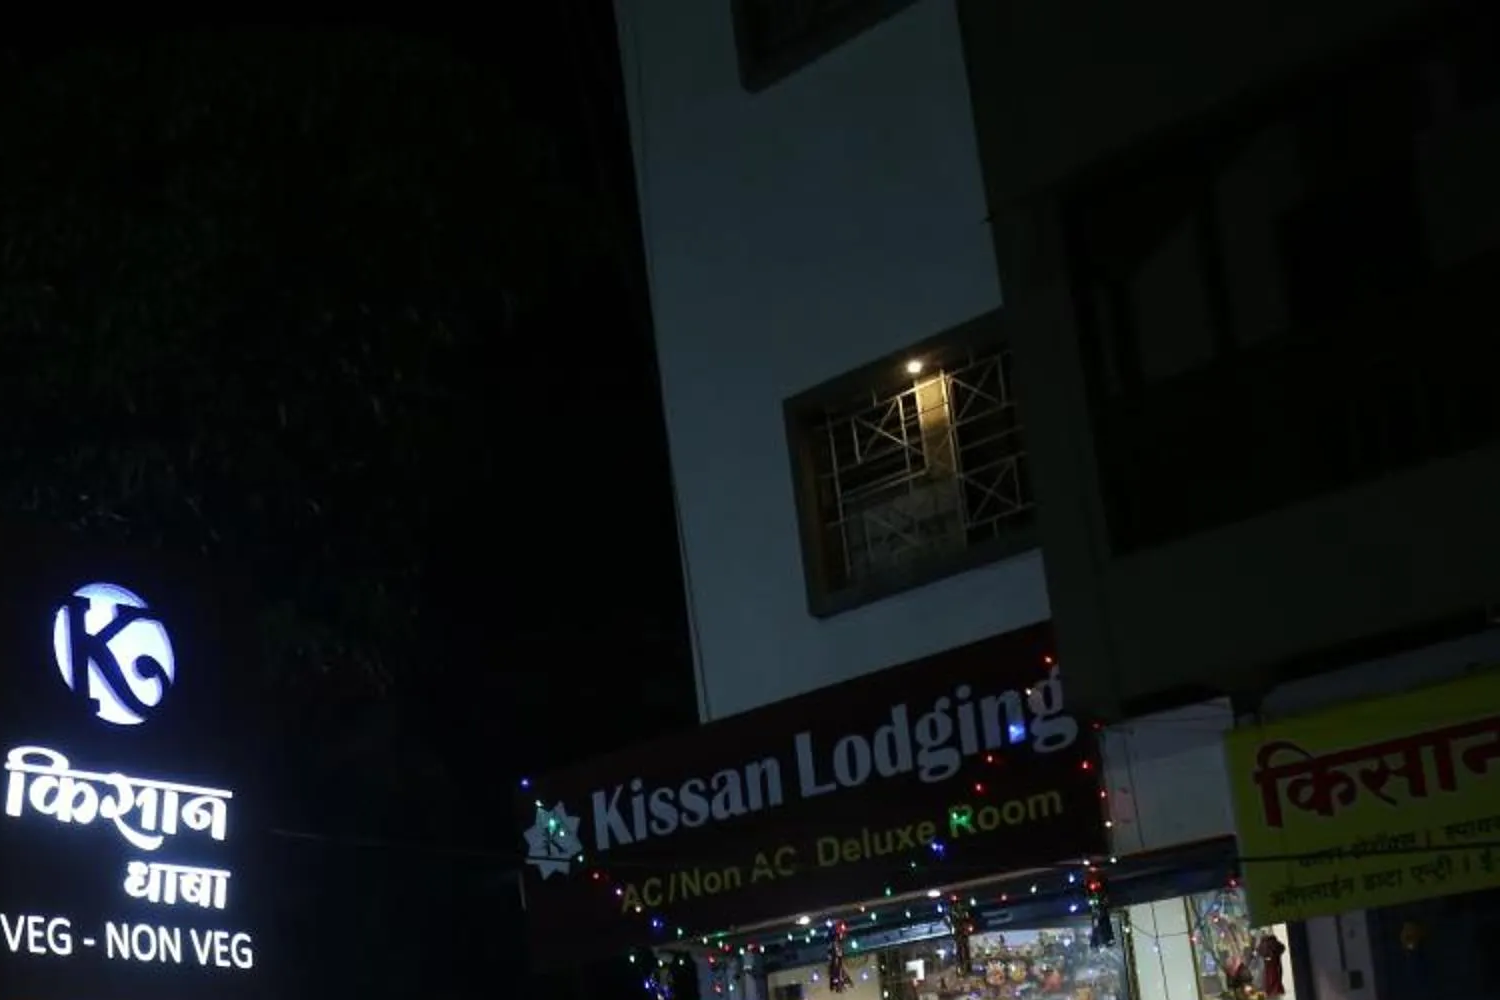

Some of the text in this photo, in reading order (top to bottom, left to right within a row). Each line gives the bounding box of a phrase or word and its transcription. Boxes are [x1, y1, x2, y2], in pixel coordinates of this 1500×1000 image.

[4, 745, 233, 851] किसान
[592, 662, 1079, 851] Kissan Lodging
[123, 860, 231, 909] धाबा
[621, 786, 1064, 914] AC/Non AC Deluxe Room
[0, 914, 72, 955] VEG
[106, 921, 182, 963] NON
[189, 928, 253, 968] VEG
